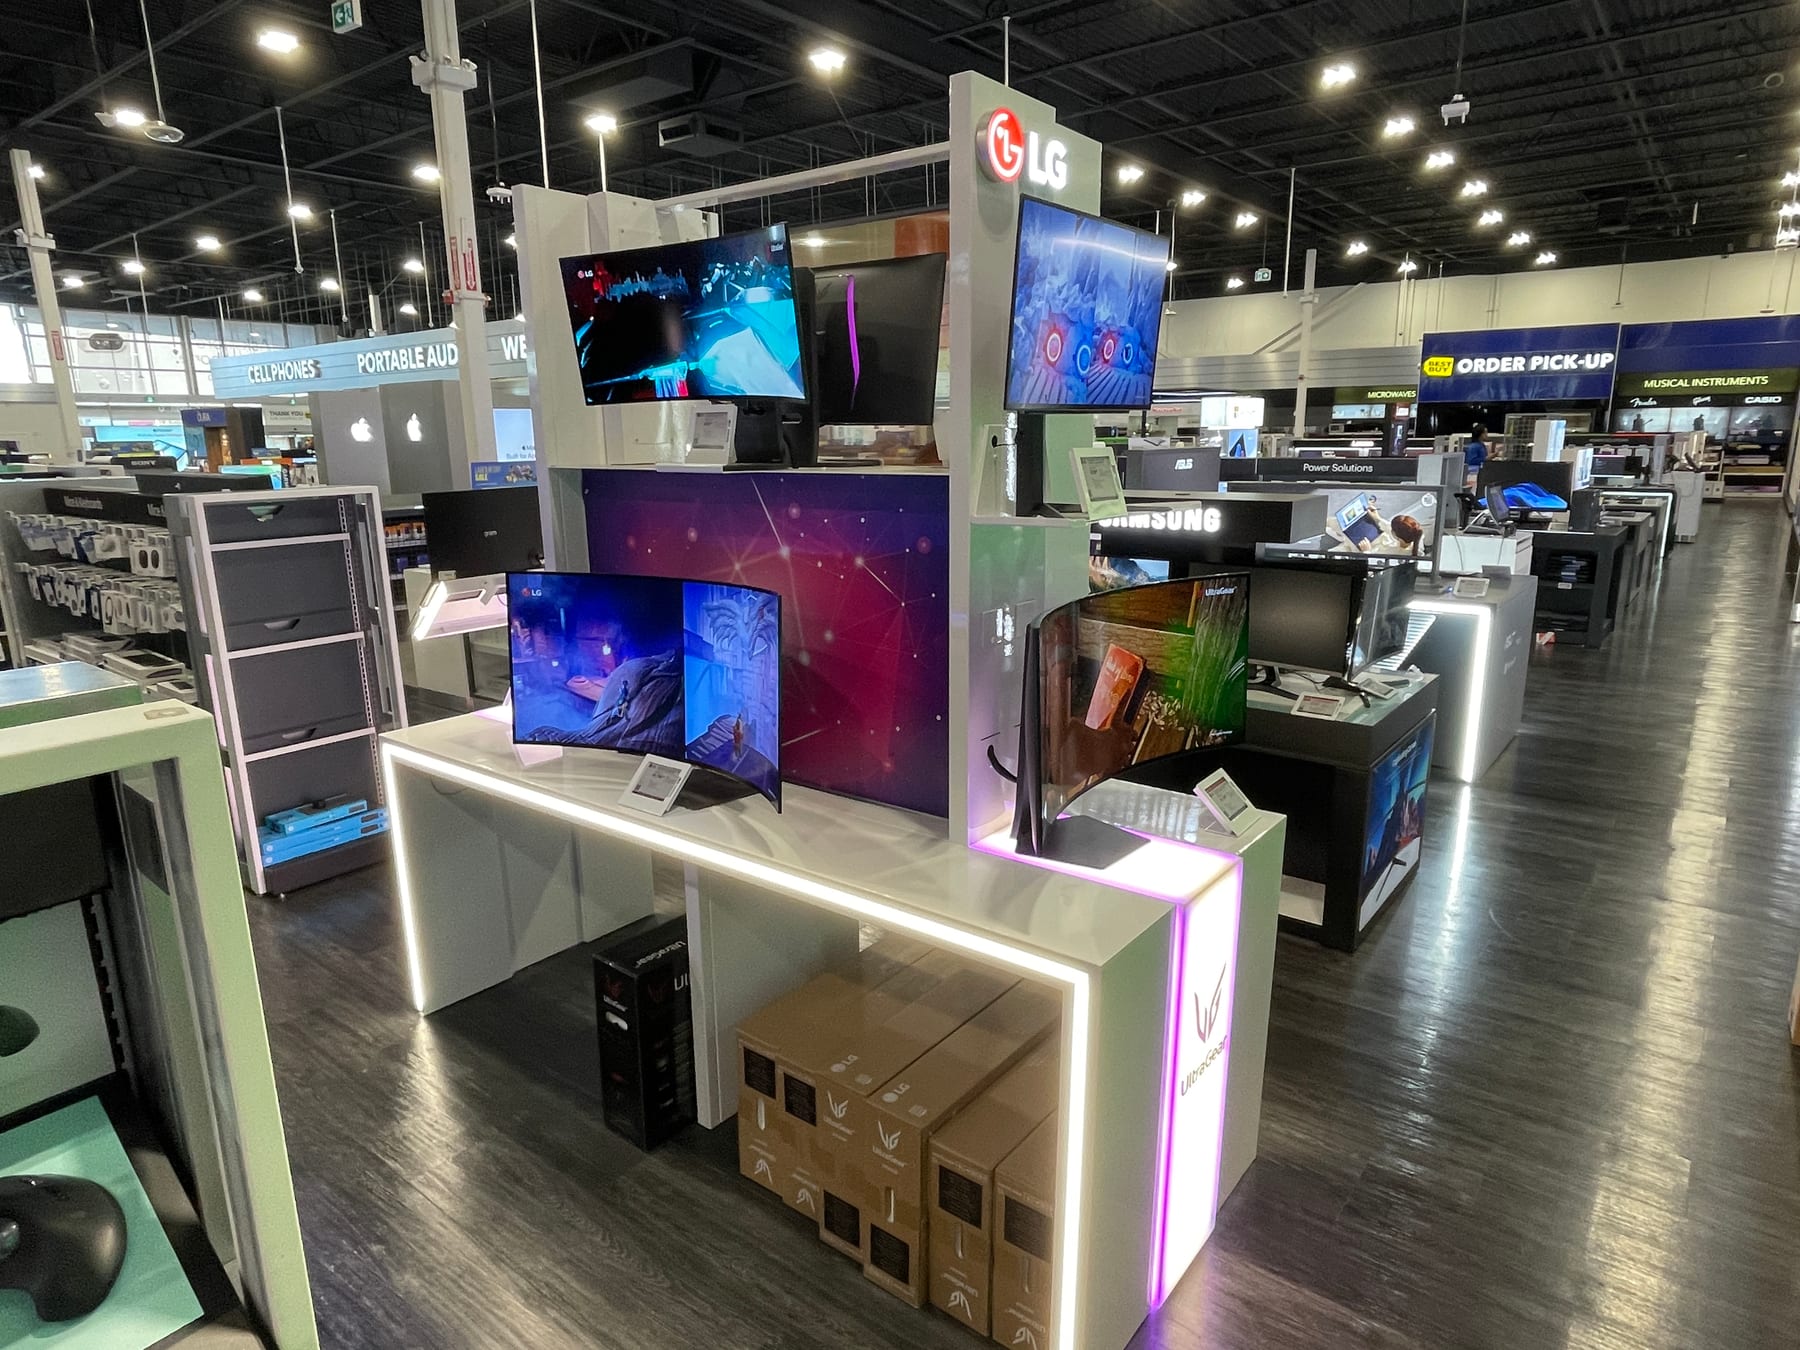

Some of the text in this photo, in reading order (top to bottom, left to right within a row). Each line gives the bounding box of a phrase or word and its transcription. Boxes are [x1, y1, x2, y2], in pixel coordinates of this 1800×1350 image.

[1028, 130, 1067, 190] LG
[584, 269, 594, 278] LG
[357, 343, 459, 374] PORTABLE AUD
[1456, 353, 1615, 374] ORDER PICK-UP
[1644, 376, 1769, 388] MUSICAL INSTRUMENTS
[1367, 390, 1417, 399] MICROWAVES
[1744, 396, 1783, 404] CASIO
[1303, 463, 1374, 473] Power Solutions
[531, 589, 542, 597] LG
[1181, 1035, 1228, 1097] UltraGear
